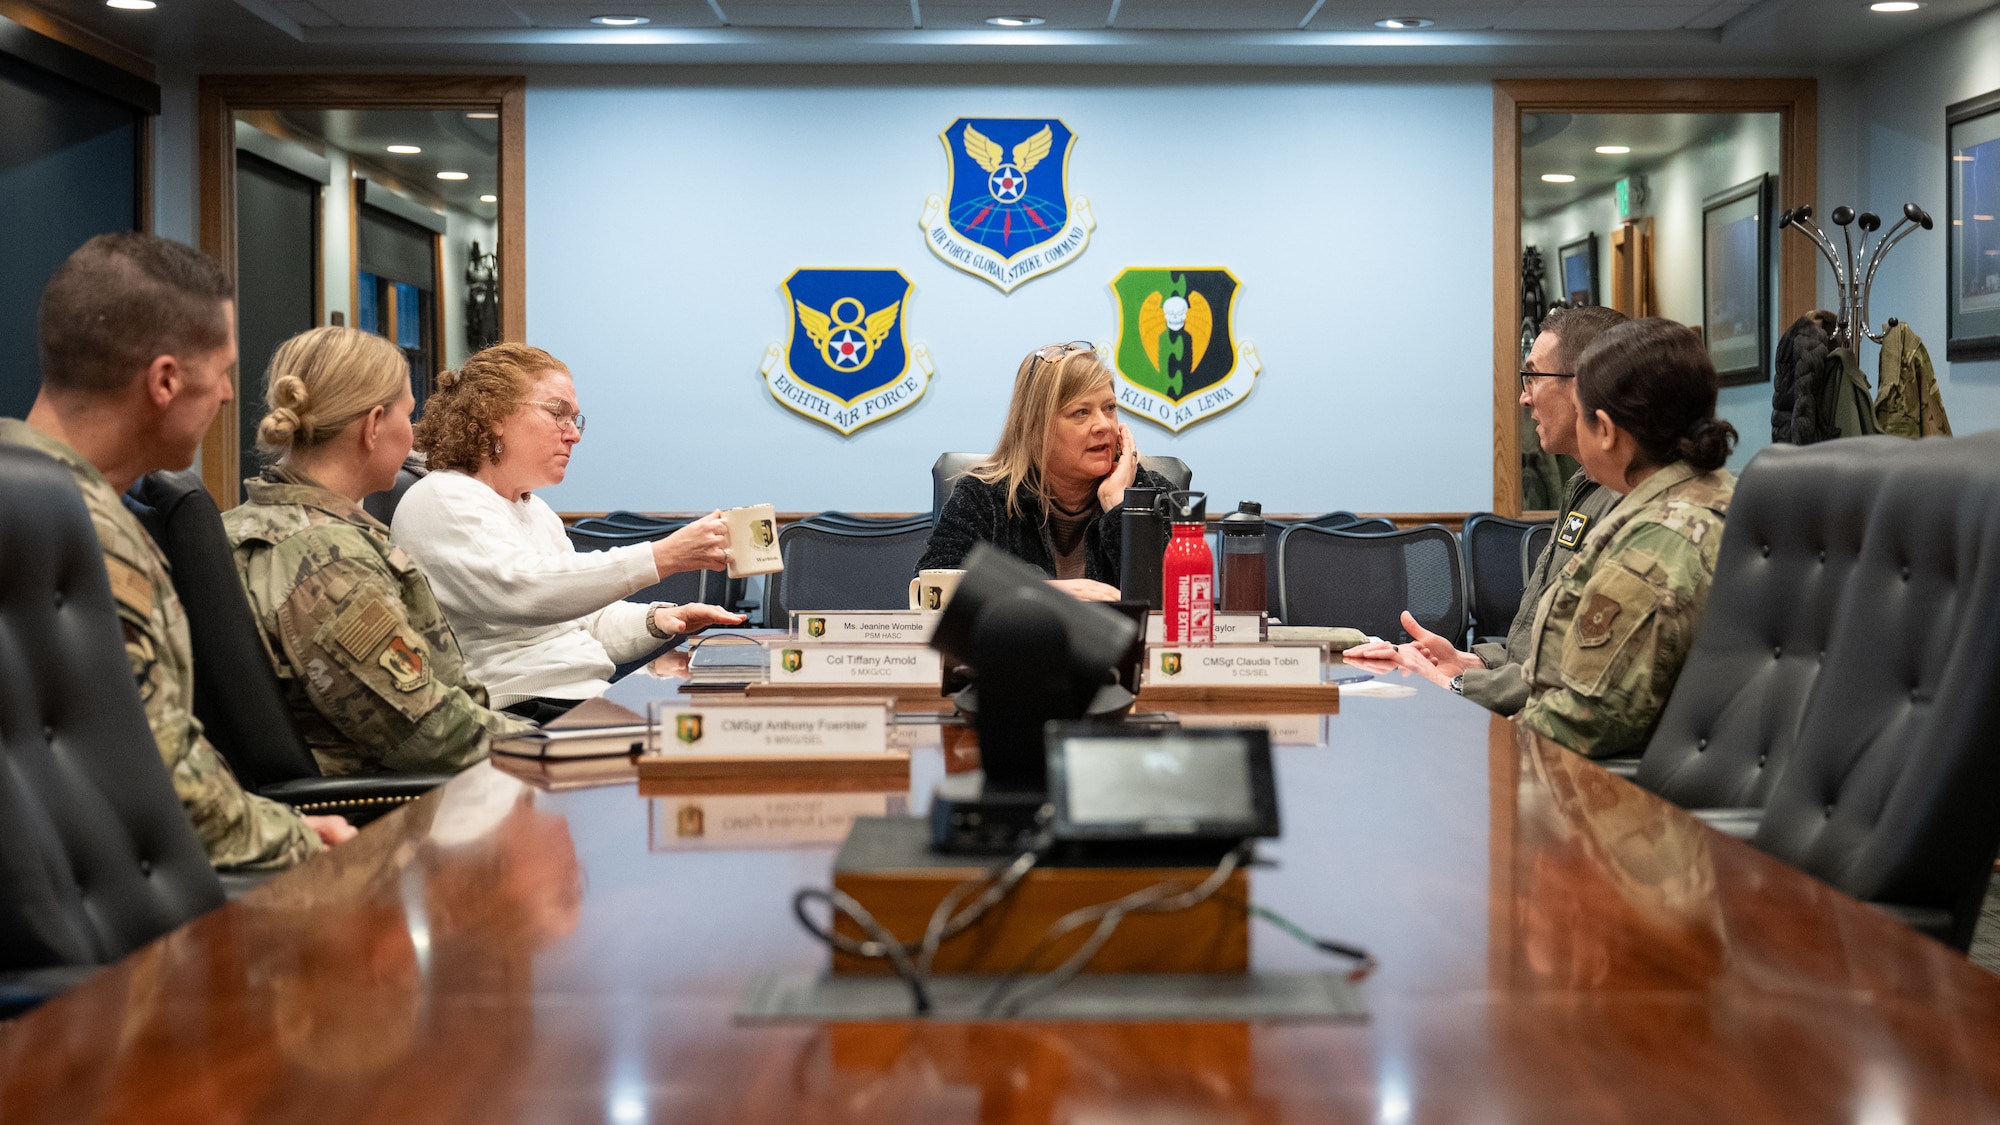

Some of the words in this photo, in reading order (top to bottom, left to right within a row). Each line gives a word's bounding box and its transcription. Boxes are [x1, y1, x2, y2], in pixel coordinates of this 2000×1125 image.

[931, 226, 947, 245] AIR
[943, 239, 972, 264] FORCE
[973, 254, 1007, 284] GLOBAL
[1008, 254, 1043, 284] STRIKE
[1044, 226, 1085, 264] COMMAND
[774, 373, 830, 417] EIGHTH
[833, 407, 860, 428] AIR
[864, 376, 918, 416] FORCE
[1120, 387, 1154, 412] KIAI
[1159, 404, 1170, 420] O
[1174, 405, 1193, 425] KA
[1197, 387, 1235, 412] LEWA
[1178, 574, 1190, 610] THIRST
[844, 622, 858, 631] Ms.
[859, 622, 890, 631] Jeanine
[891, 622, 924, 631] Womble
[826, 655, 844, 665] Col
[846, 655, 881, 668] Tiffany
[883, 655, 917, 666] Arnold
[1202, 656, 1234, 669] CMSgt
[1236, 656, 1271, 666] Claudia
[1273, 657, 1299, 666] Tobin
[1232, 669, 1238, 677] 5
[1239, 669, 1269, 677] CS/SEL
